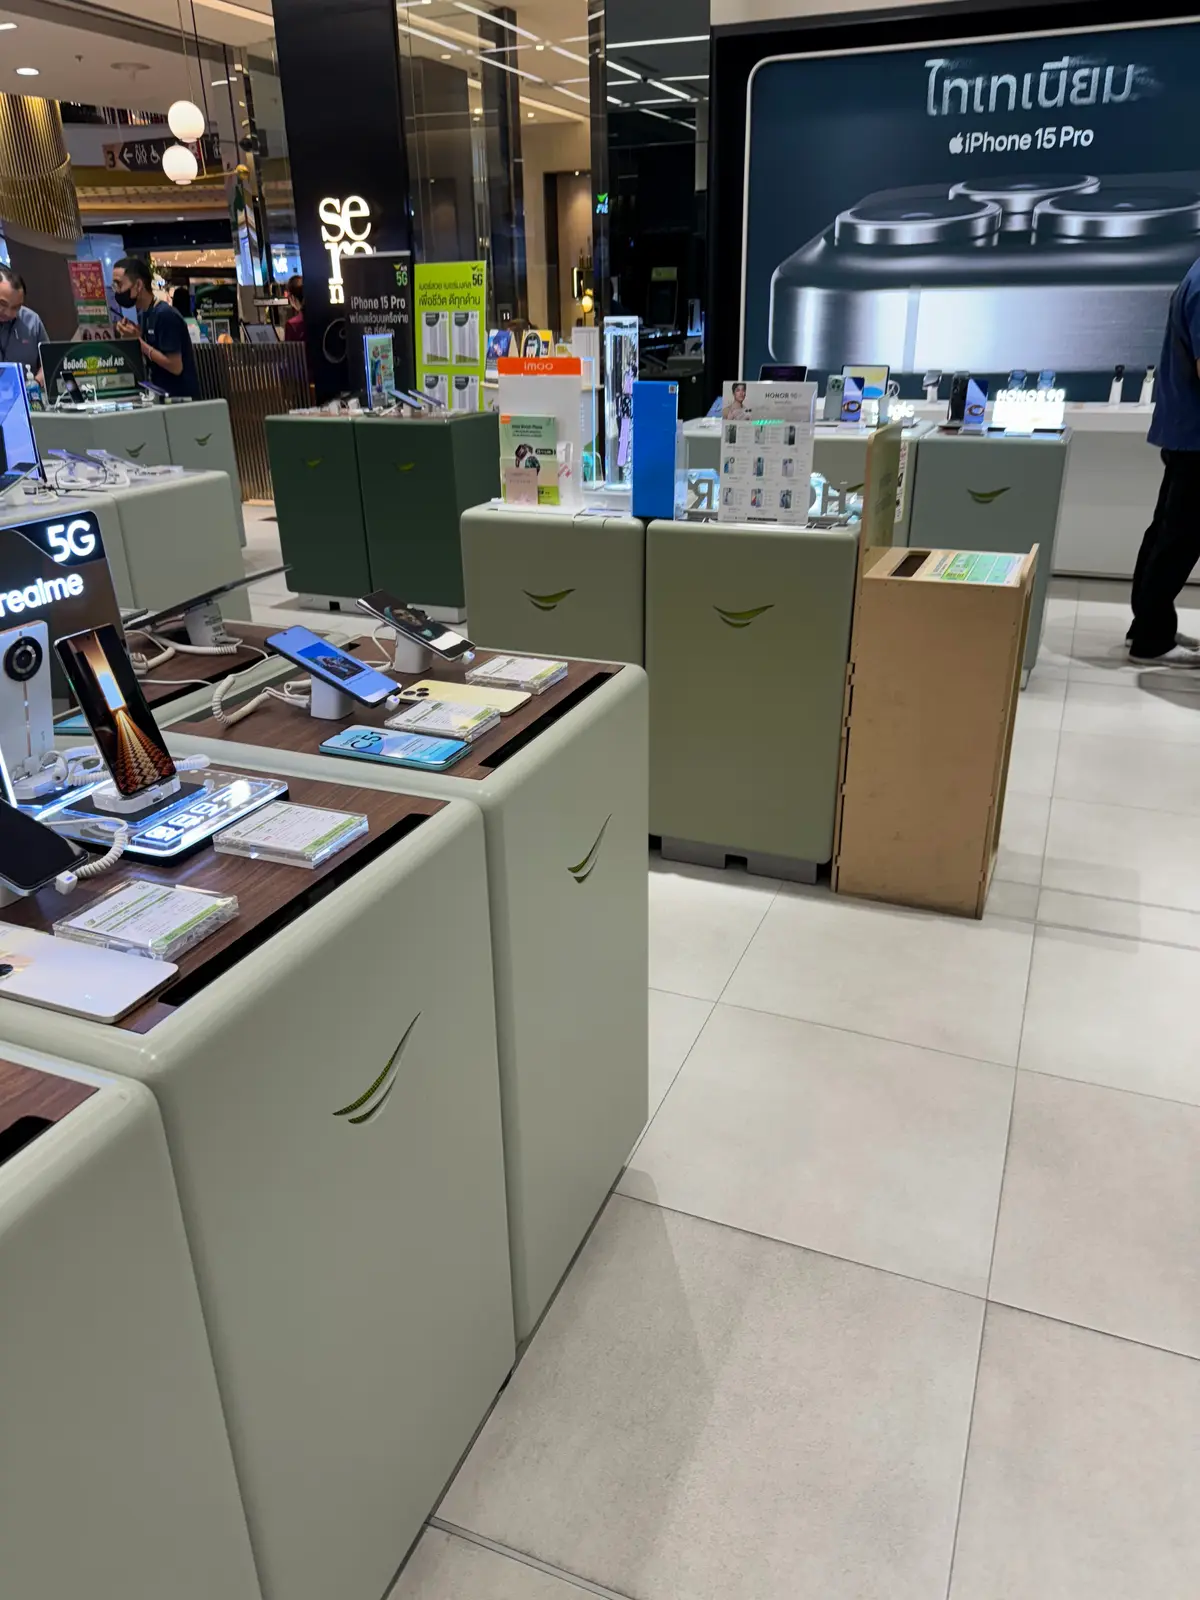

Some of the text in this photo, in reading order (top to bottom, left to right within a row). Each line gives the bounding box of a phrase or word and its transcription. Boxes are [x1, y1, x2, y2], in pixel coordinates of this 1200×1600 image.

[924, 56, 1135, 117] ไทเทเนียม
[964, 125, 1095, 154] iPhone 15 Pro
[396, 271, 408, 286] 5G
[472, 273, 483, 287] 5G
[350, 295, 406, 309] iPhone 15 Pro
[524, 361, 554, 371] imoo
[765, 391, 789, 400] HONOR
[996, 388, 1046, 402] HONOR
[47, 519, 96, 563] 5G
[0, 573, 84, 618] realme
[350, 731, 389, 750] C51
